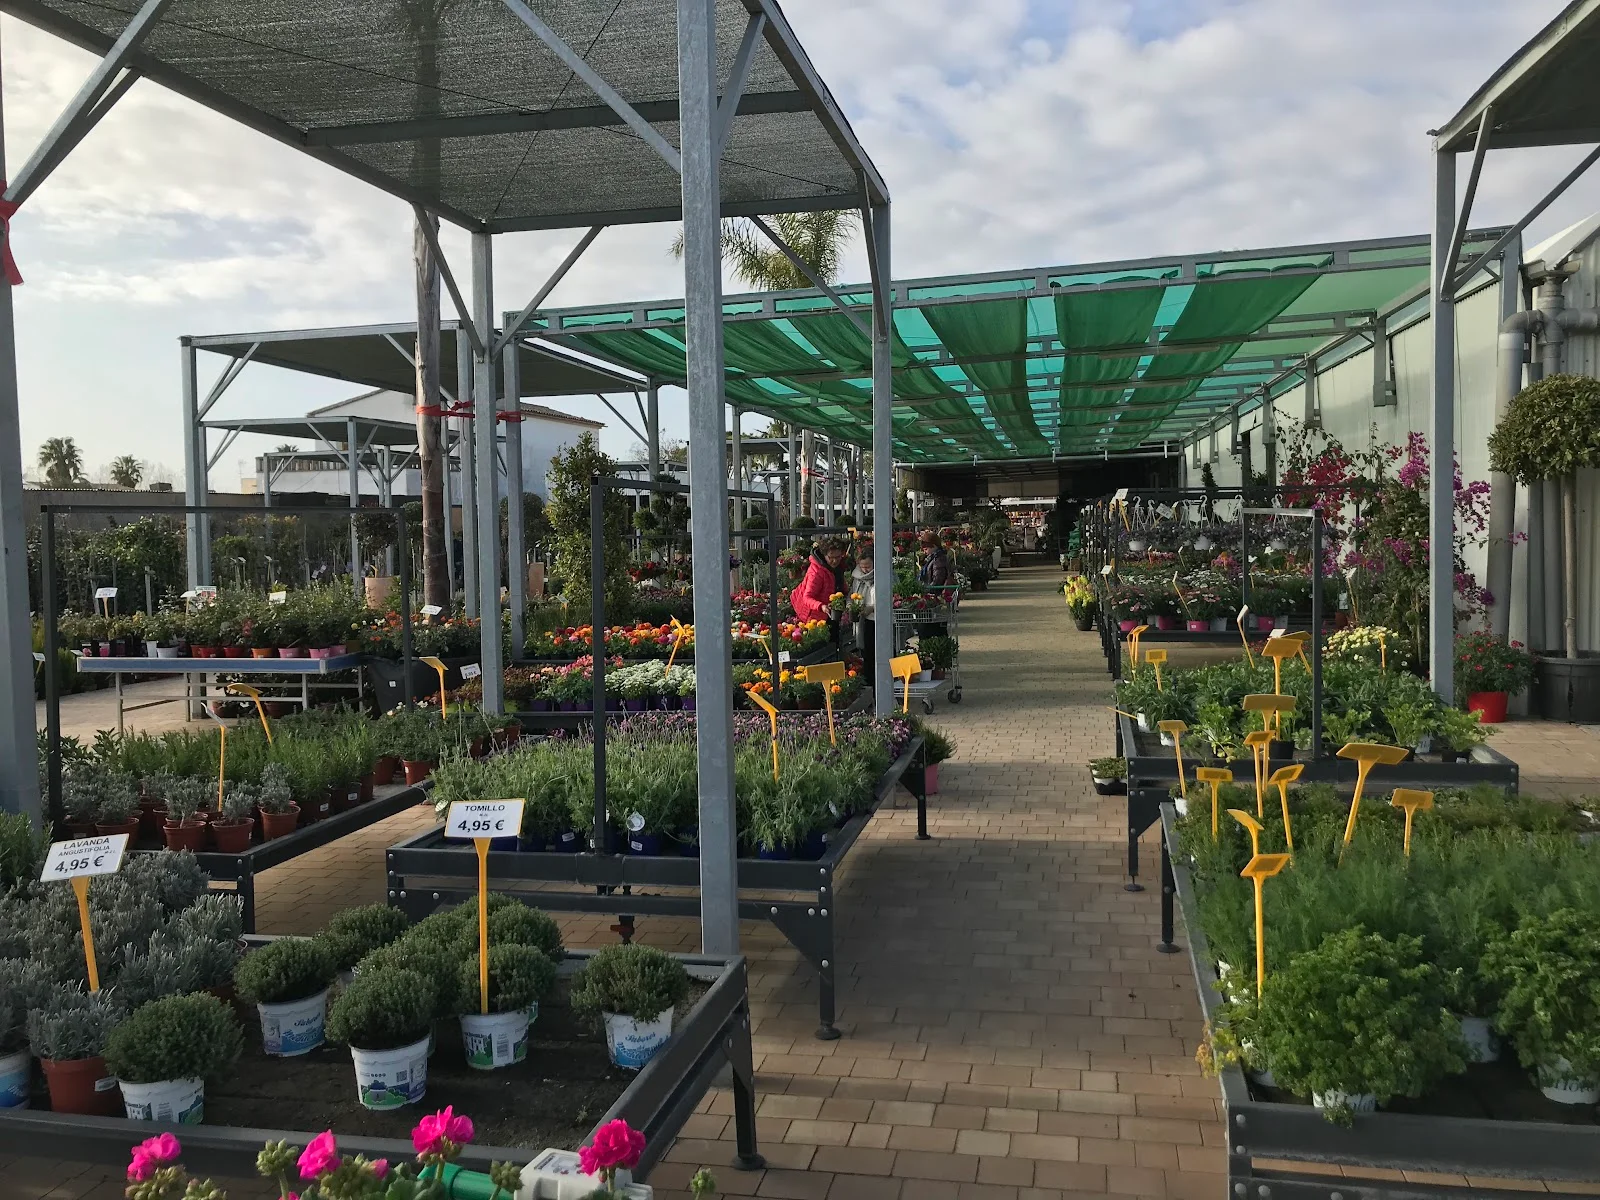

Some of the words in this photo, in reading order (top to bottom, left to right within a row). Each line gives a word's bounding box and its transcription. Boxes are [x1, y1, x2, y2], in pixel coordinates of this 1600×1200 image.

[457, 820, 491, 832] 4,95
[495, 819, 505, 831] €
[64, 838, 109, 849] LAVANDA
[58, 845, 110, 856] ANGUSTIFOLIA
[55, 857, 89, 873] 4,95
[94, 855, 105, 867] €
